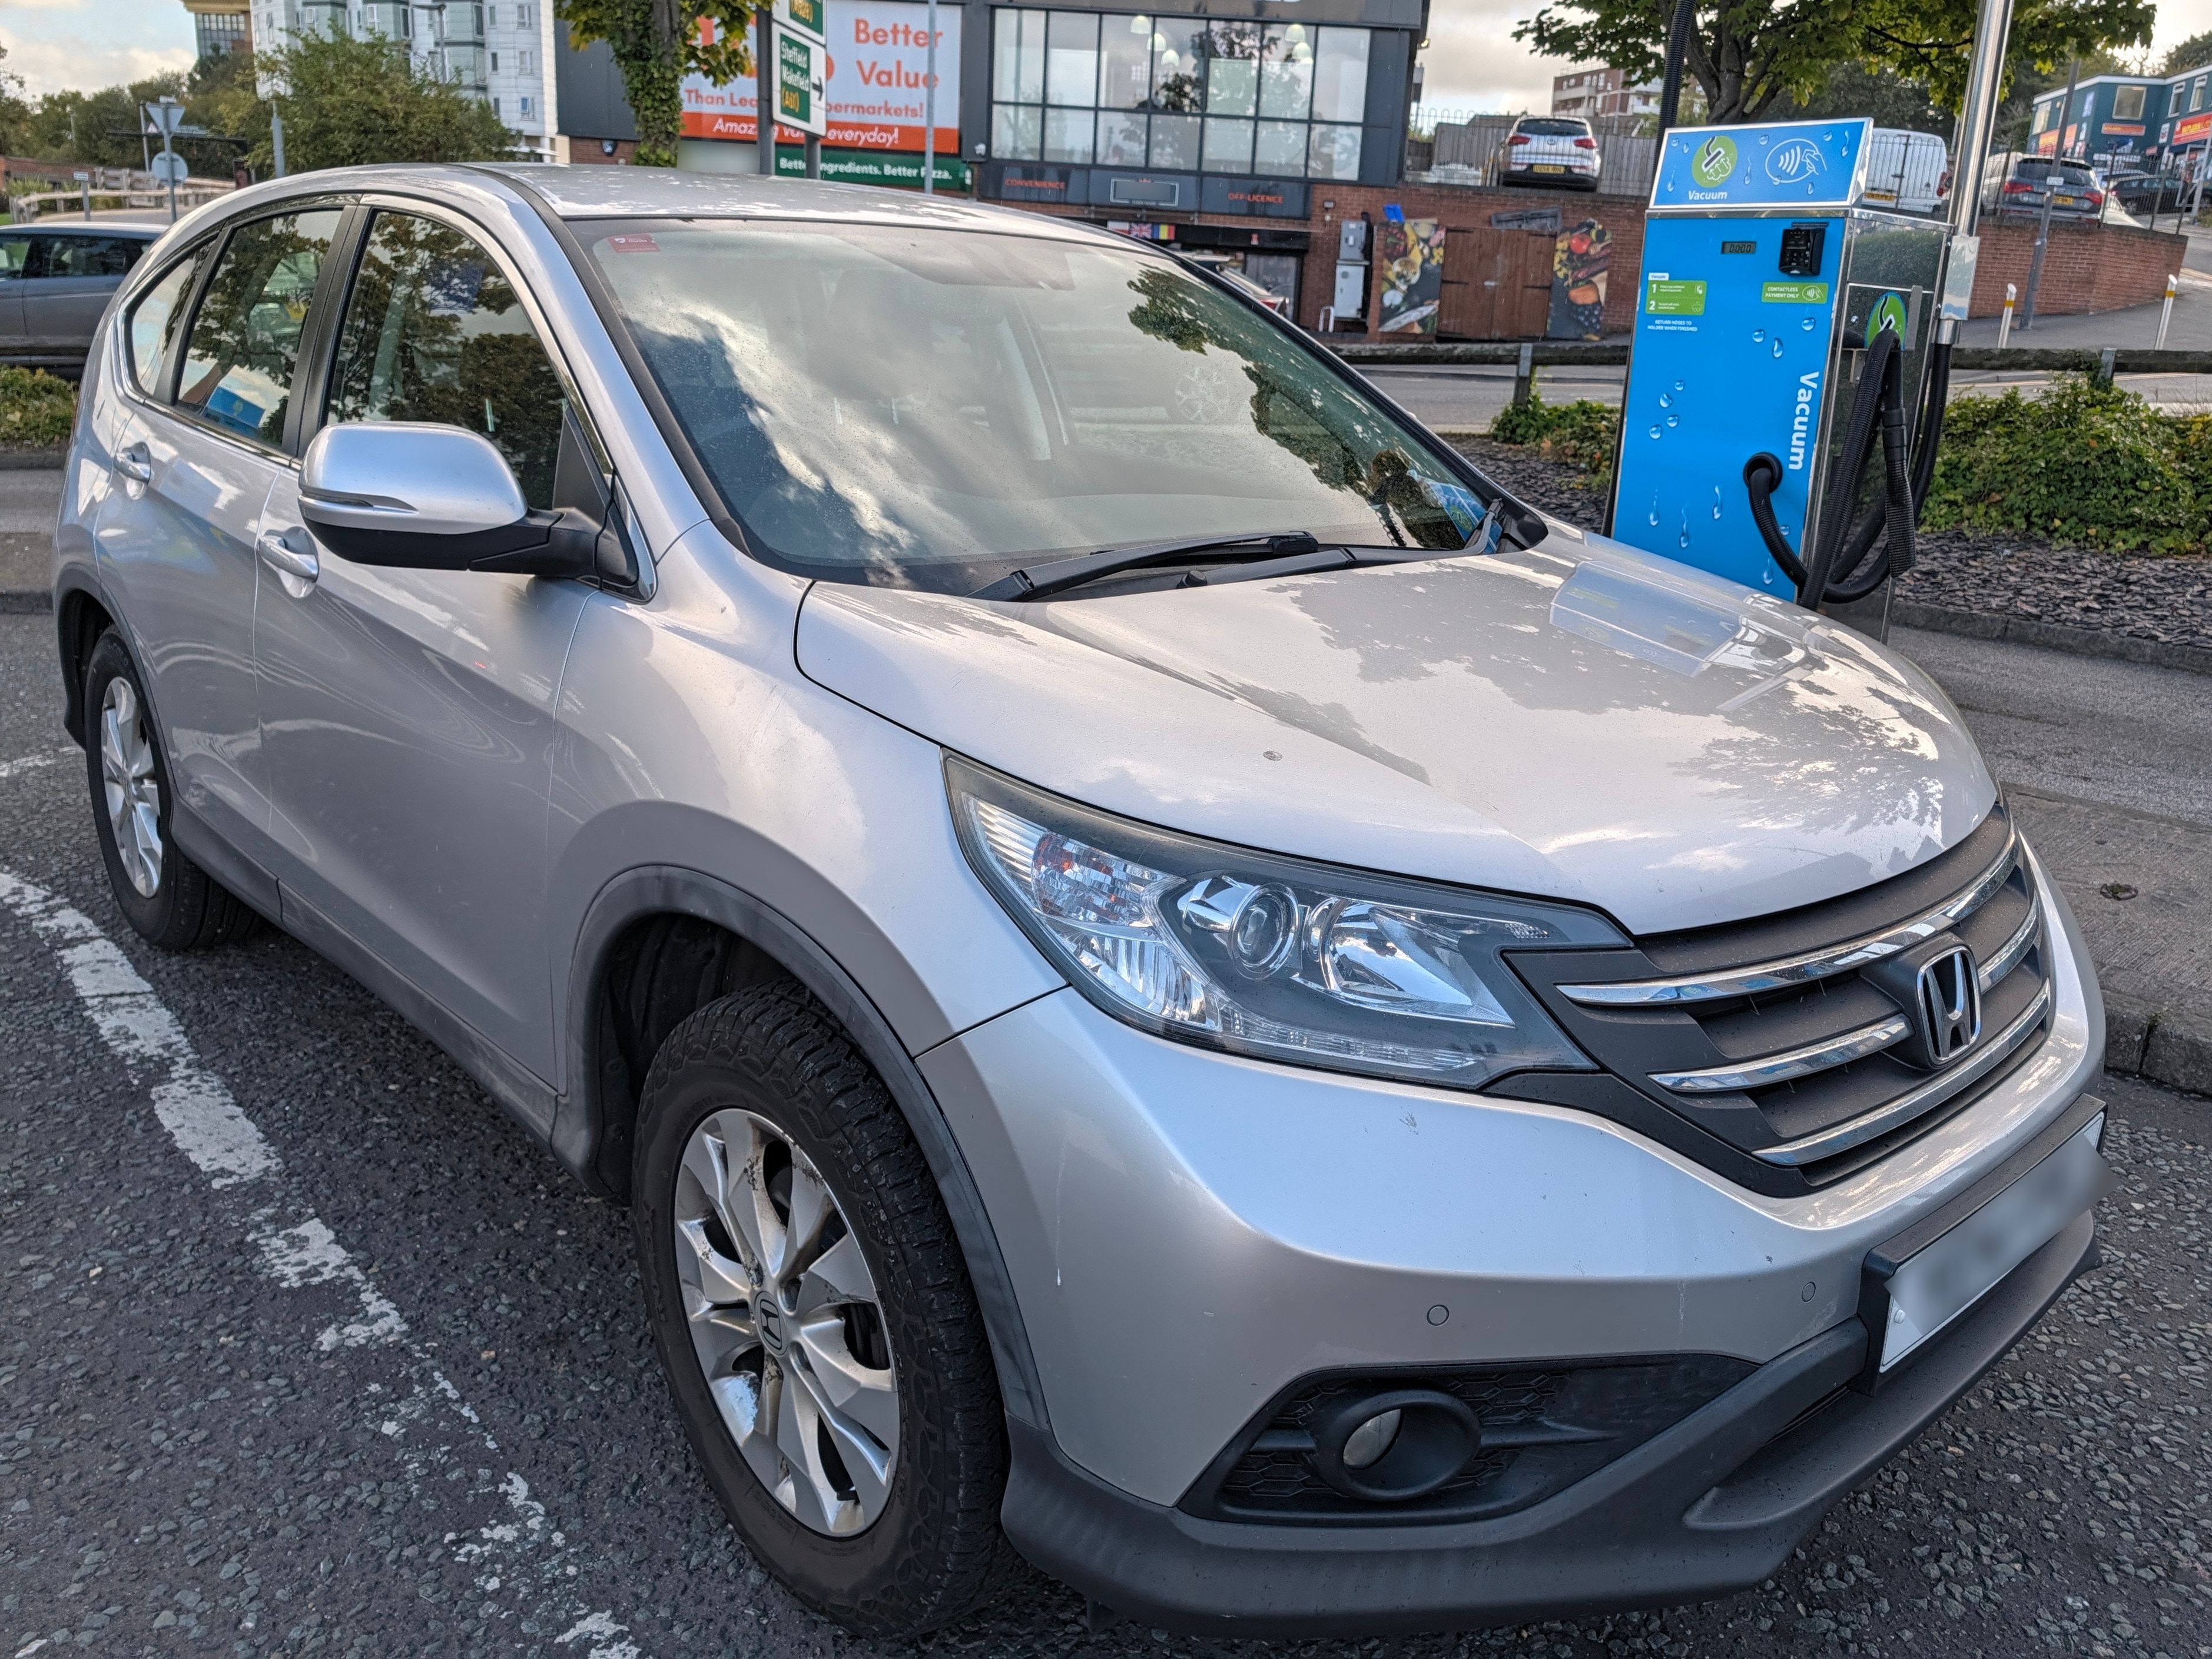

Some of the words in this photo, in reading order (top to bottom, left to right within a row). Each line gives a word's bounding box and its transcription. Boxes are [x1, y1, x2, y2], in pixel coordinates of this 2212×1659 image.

[855, 18, 943, 48] Better
[781, 41, 808, 69] Sheffield
[781, 64, 810, 92] Wakefield
[855, 59, 939, 88] Value
[685, 89, 725, 104] Than
[827, 125, 900, 147] everyday!
[820, 161, 881, 175] ngredients.
[883, 164, 918, 177] Better
[920, 166, 953, 180] Pzza.
[1004, 179, 1066, 190] CONVENIENCE
[1228, 193, 1284, 204] OFF-LICENCE
[1688, 190, 1727, 201] Vacuum
[1652, 283, 1657, 293] 1
[1649, 300, 1656, 310] 2
[1788, 371, 1820, 470] Vacuum
